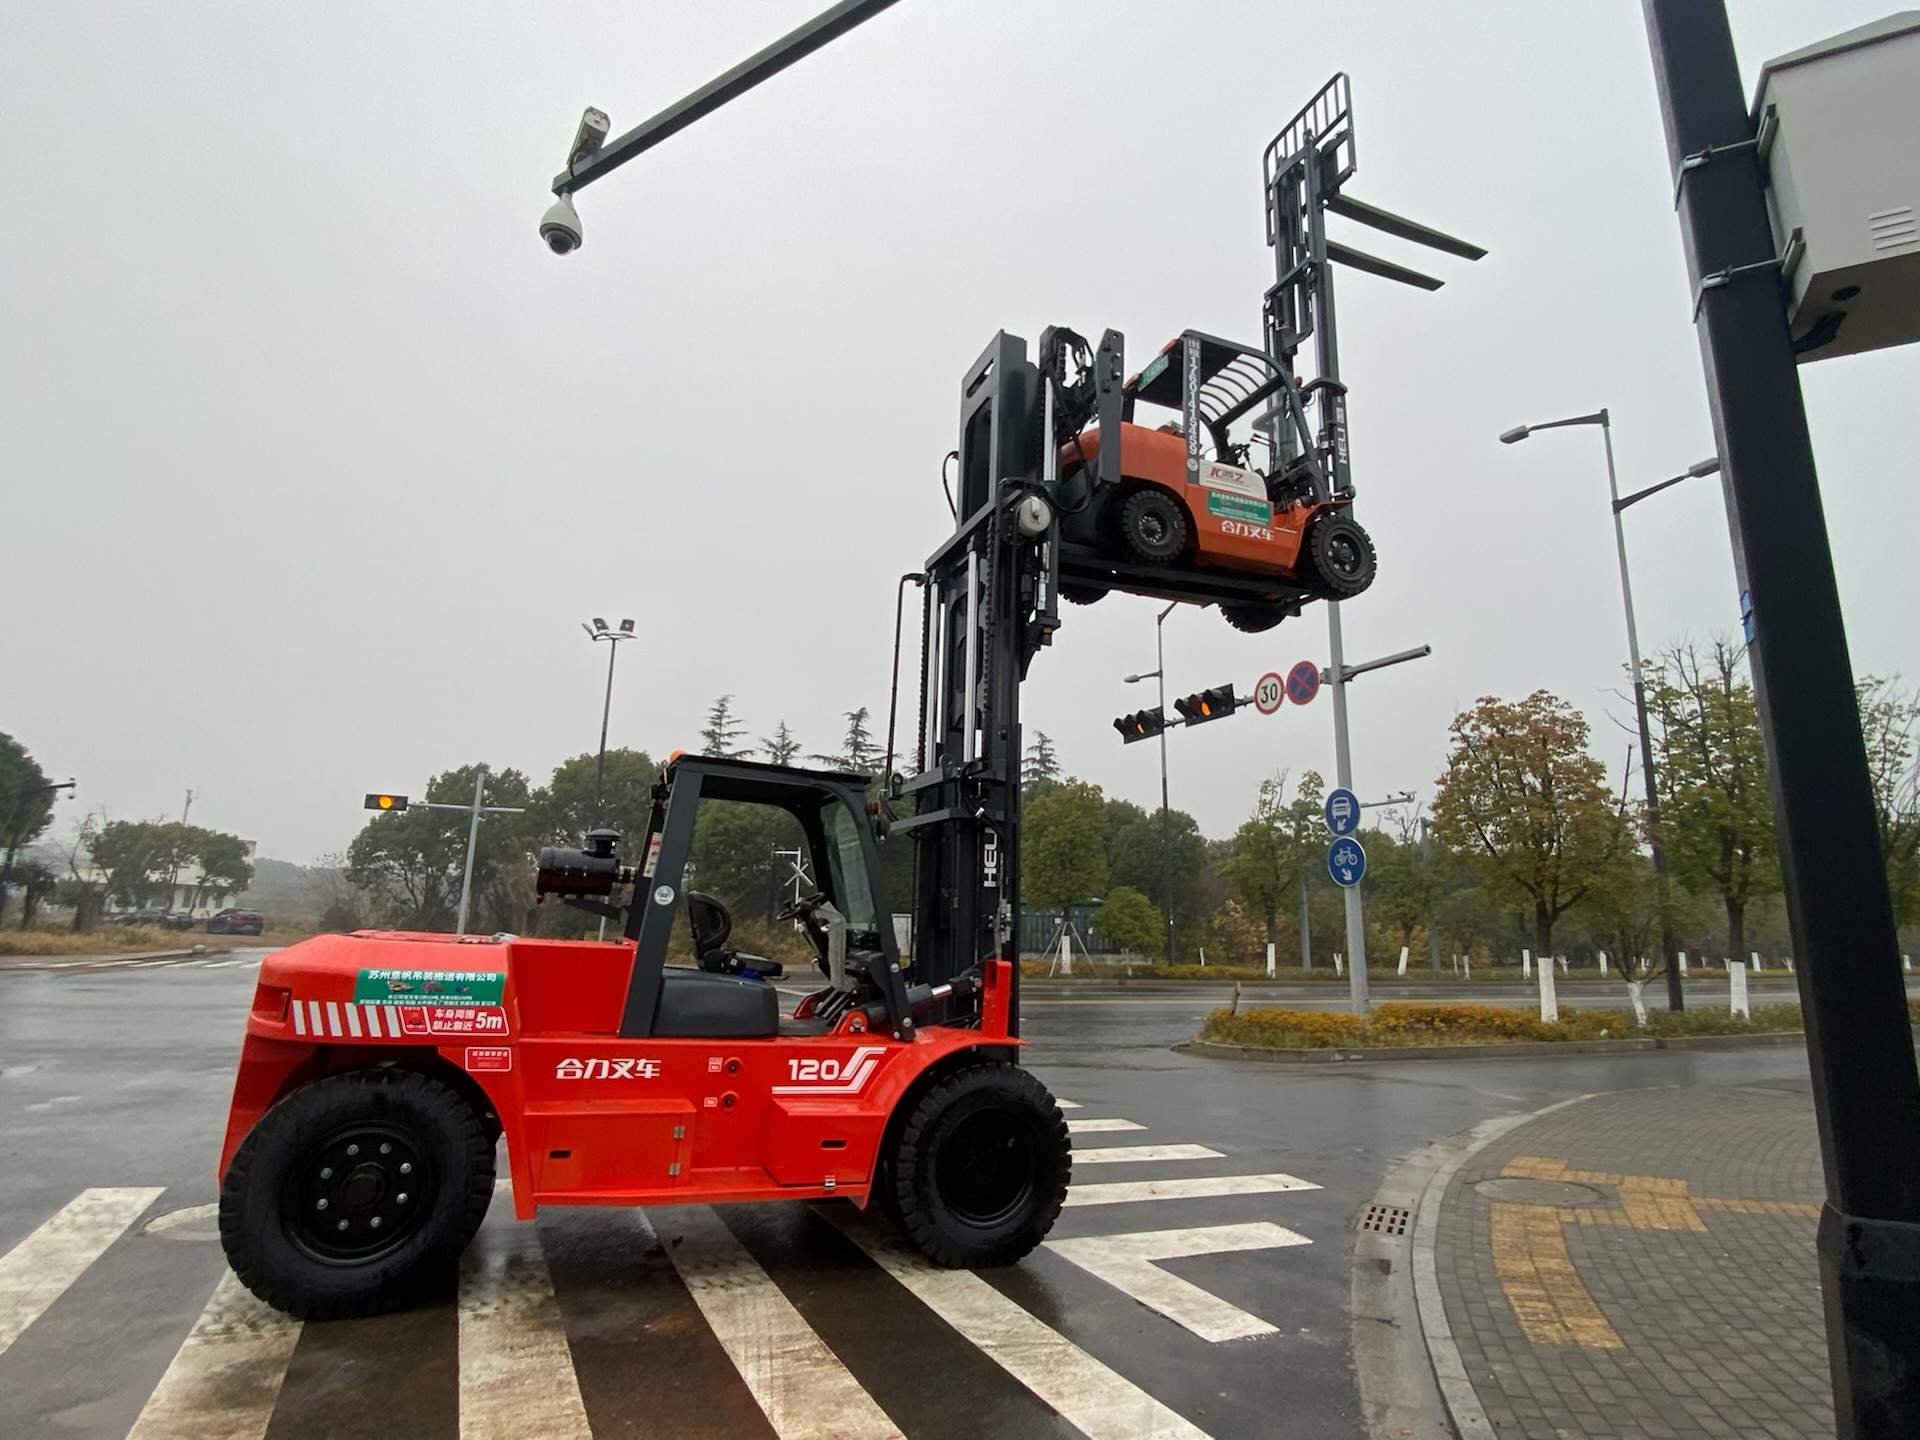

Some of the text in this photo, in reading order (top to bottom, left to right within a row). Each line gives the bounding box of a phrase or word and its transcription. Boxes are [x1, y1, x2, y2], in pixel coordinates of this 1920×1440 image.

[1337, 427, 1348, 464] HELI
[1222, 520, 1275, 541] 合力叉车
[1260, 683, 1278, 704] 30
[435, 1009, 476, 1019] 车身周围
[475, 1011, 503, 1029] 5m
[556, 1058, 662, 1080] 合力叉车
[788, 1059, 840, 1081] 120
